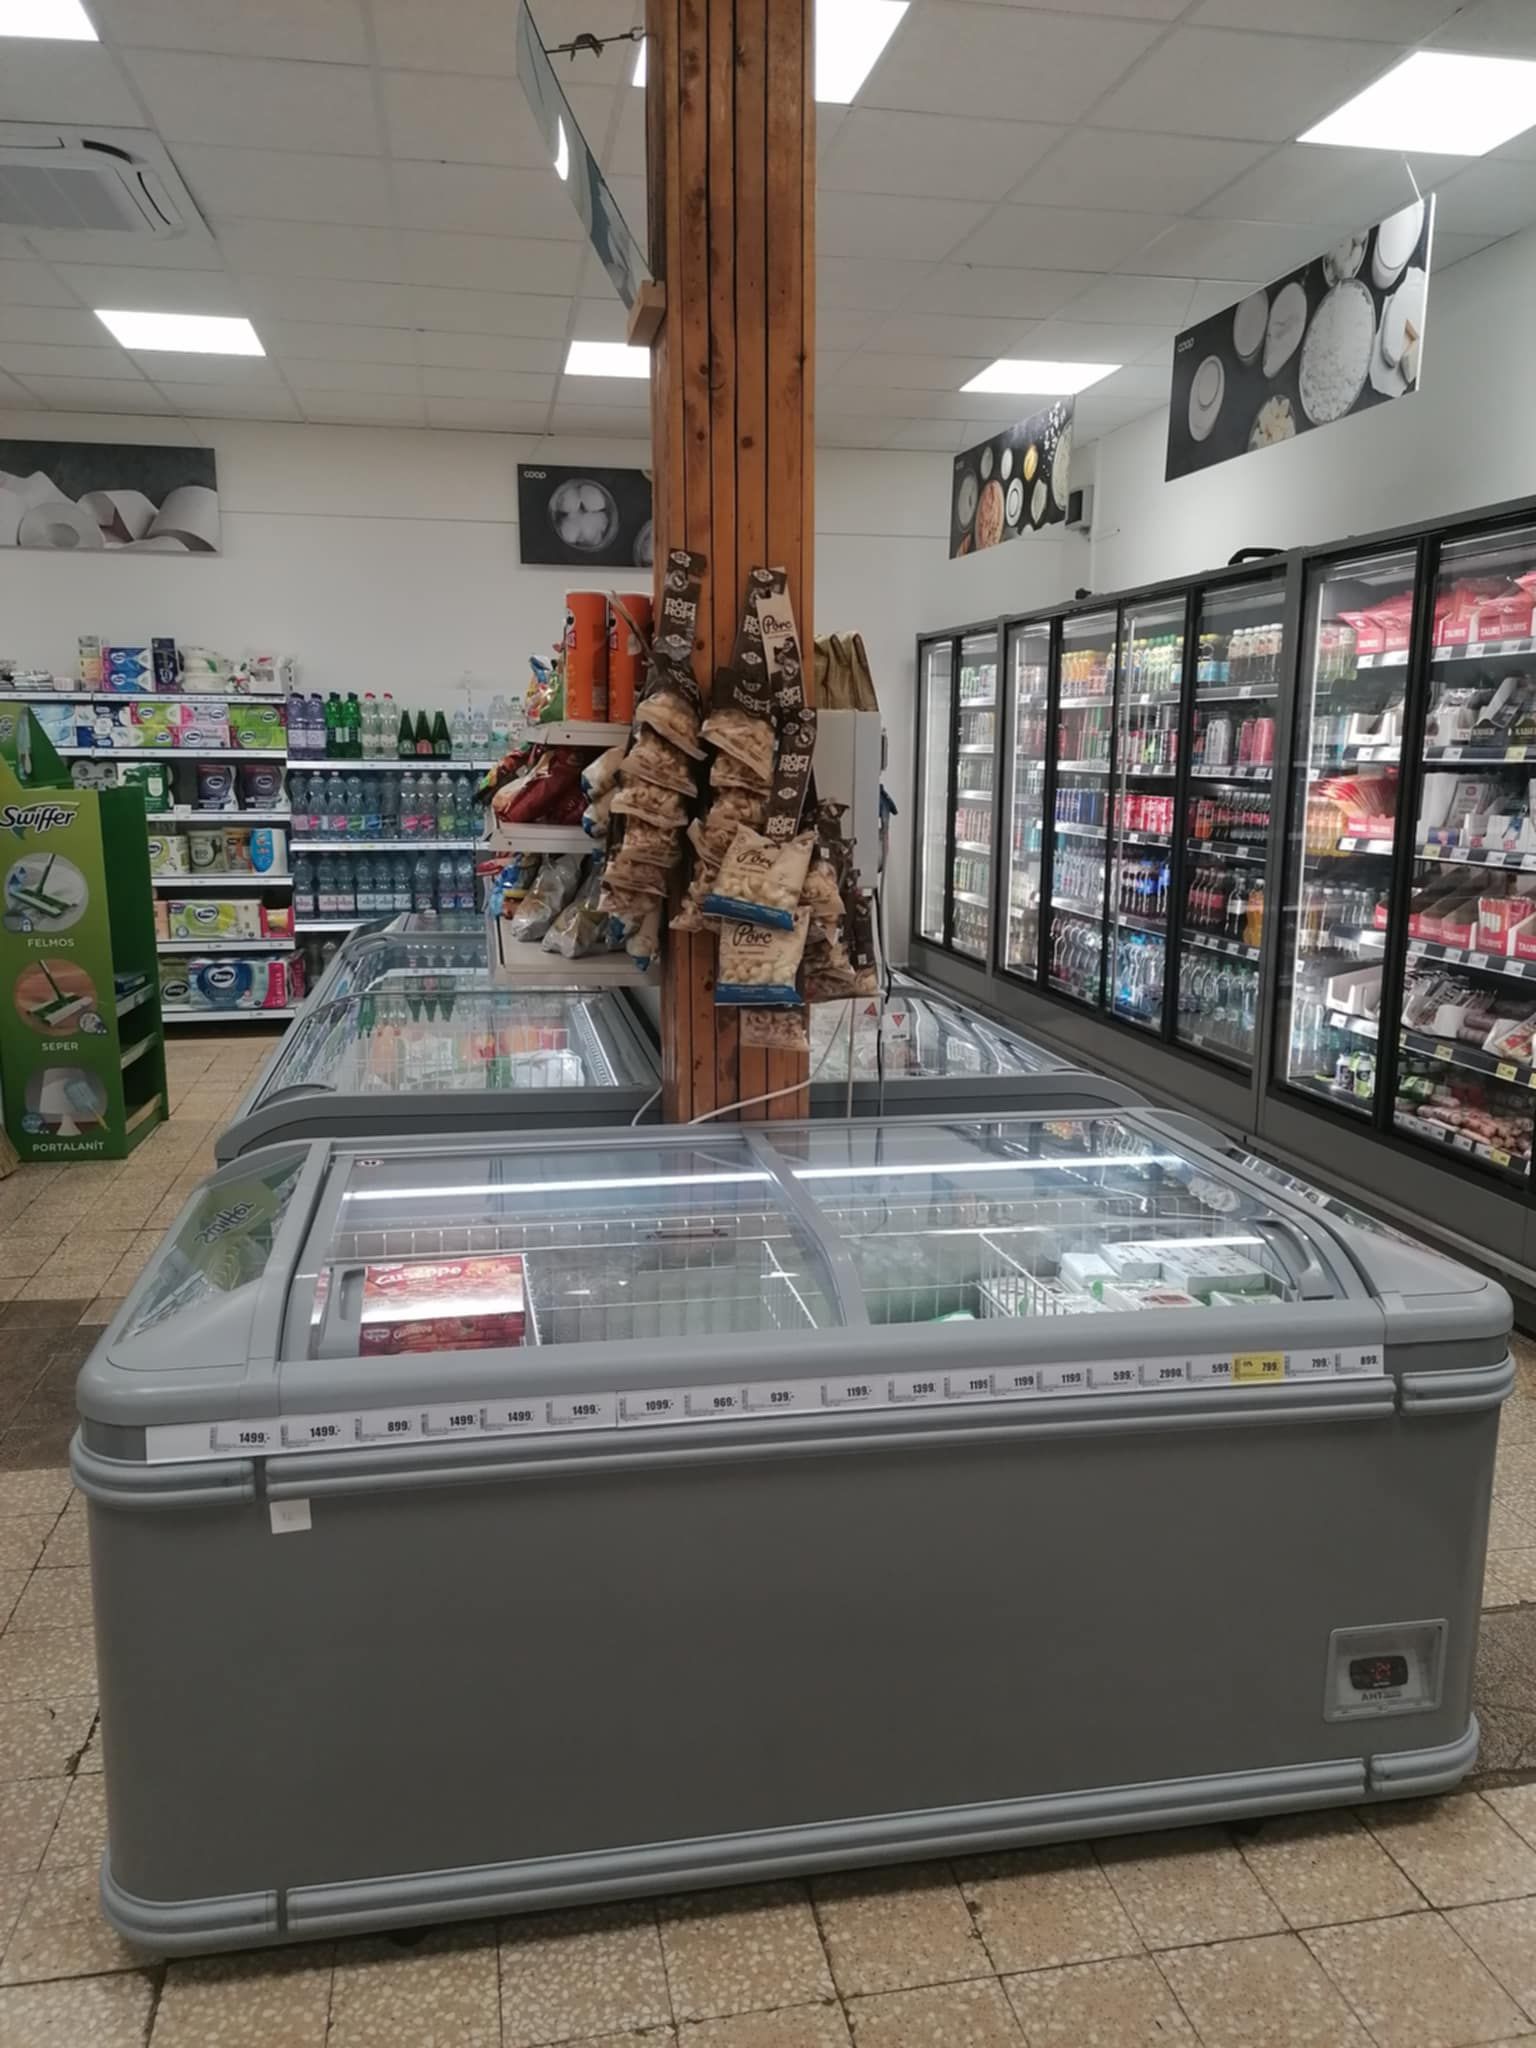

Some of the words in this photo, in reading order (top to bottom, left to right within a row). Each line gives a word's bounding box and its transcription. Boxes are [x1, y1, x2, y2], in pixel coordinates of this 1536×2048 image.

[0, 806, 76, 833] Swiffer
[27, 938, 75, 948] FELMOS
[41, 1042, 79, 1051] SEPER
[32, 1141, 105, 1153] PORTALANÍT
